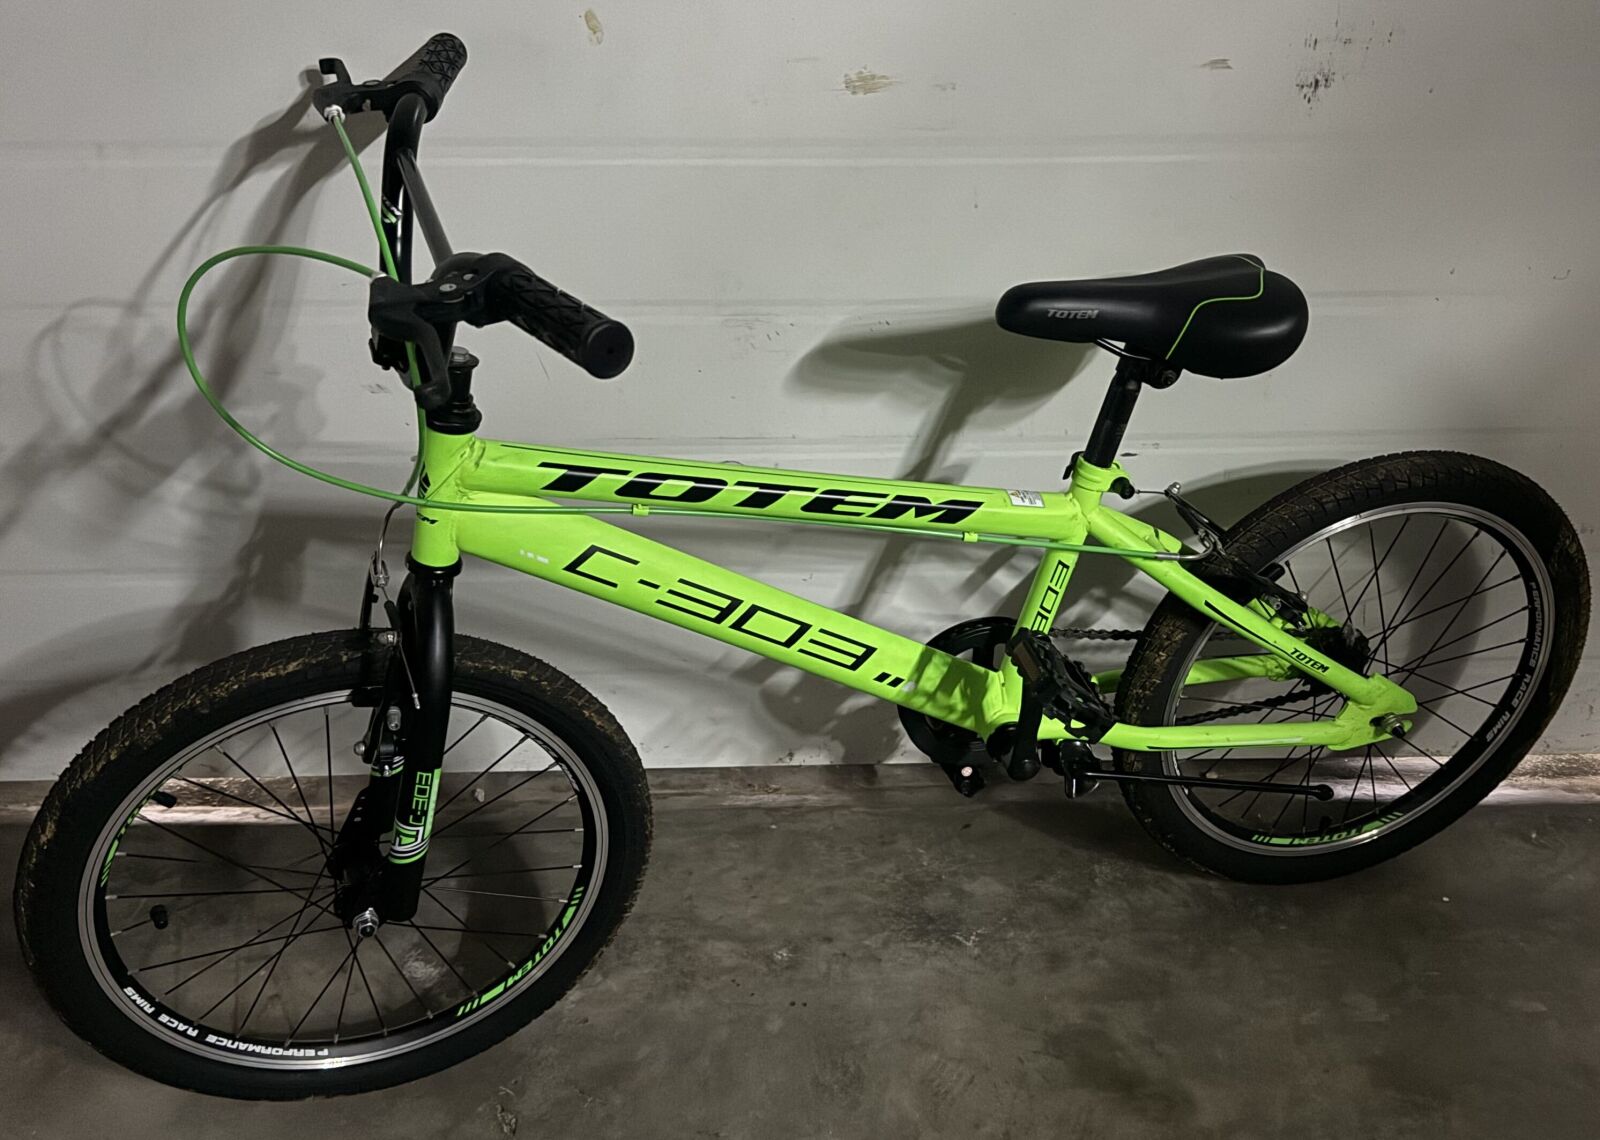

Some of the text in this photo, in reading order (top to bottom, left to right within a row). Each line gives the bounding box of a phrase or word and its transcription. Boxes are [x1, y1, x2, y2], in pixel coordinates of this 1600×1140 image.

[1047, 308, 1100, 319] TOTEM
[537, 461, 984, 524] TOTEM
[562, 544, 878, 671] C-303
[1290, 647, 1330, 673] TOTEM
[1485, 581, 1543, 743] PERFORMANCE RACE RIMS
[1292, 828, 1361, 846] TOTEM
[506, 927, 564, 988] TOTEM
[123, 986, 329, 1057] PERFORMANCE RACE RIMS
